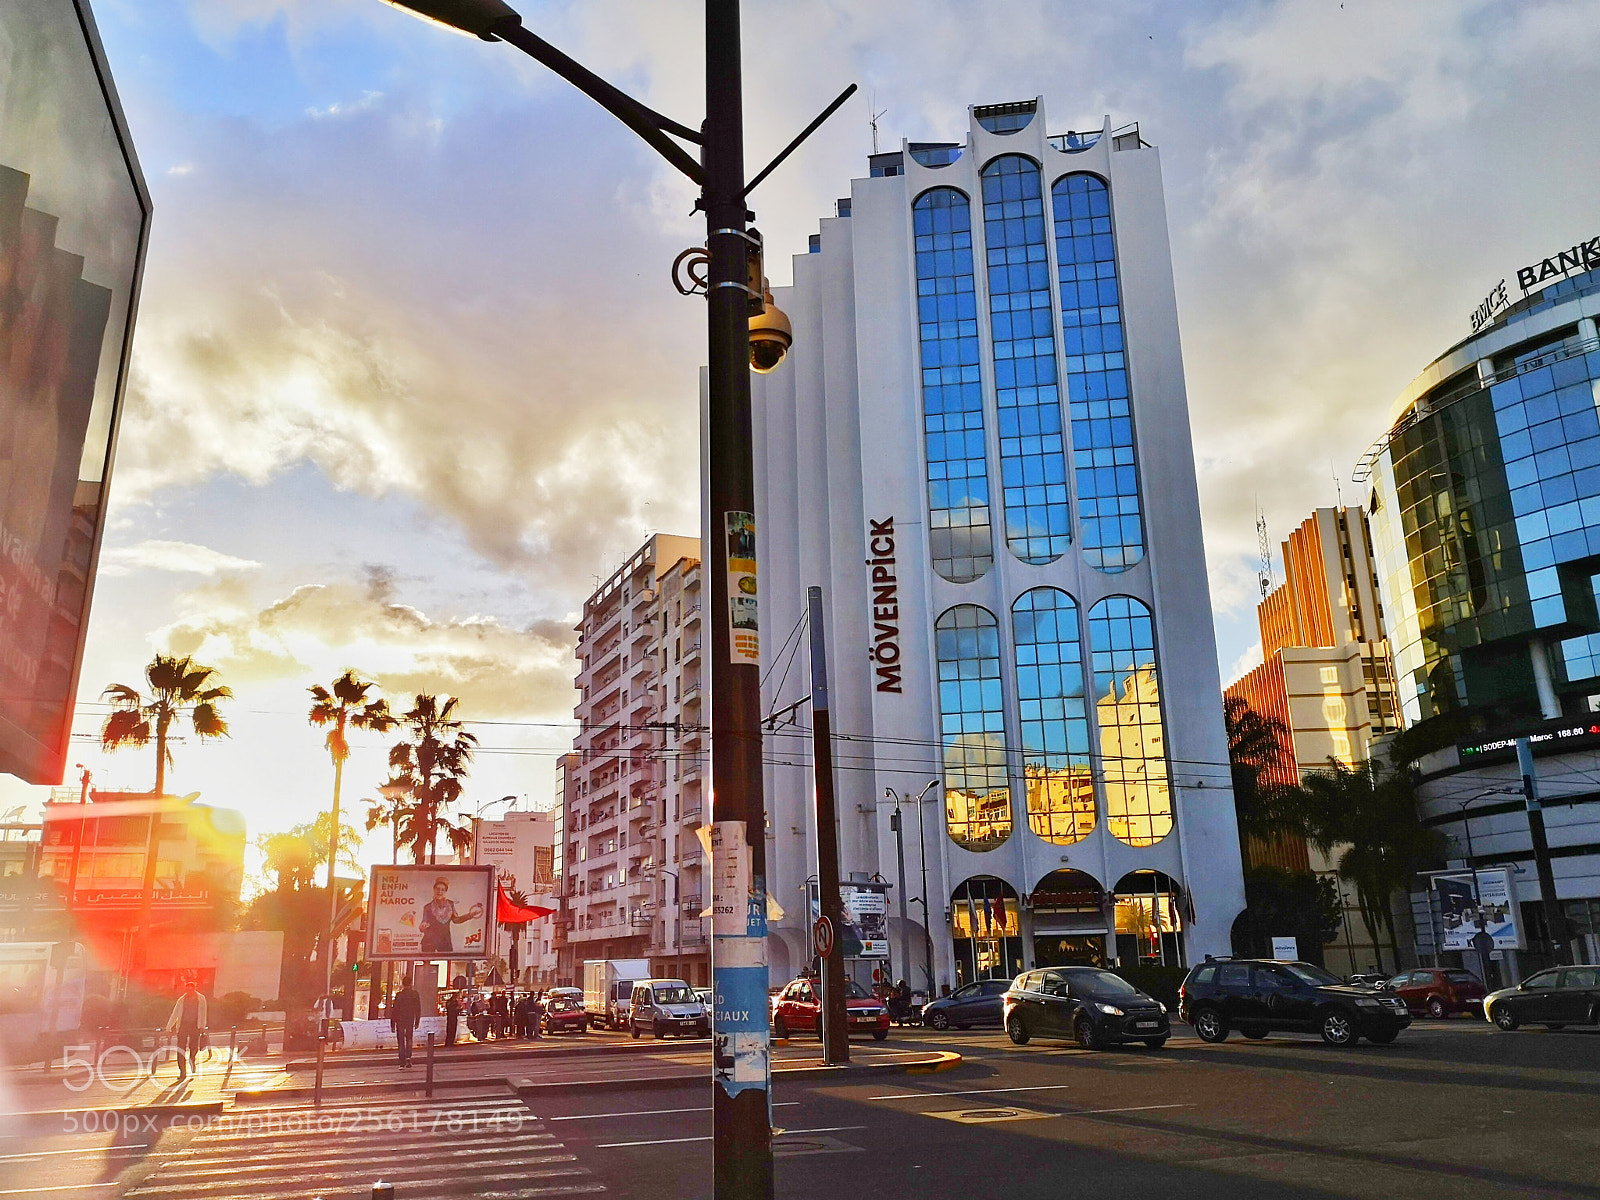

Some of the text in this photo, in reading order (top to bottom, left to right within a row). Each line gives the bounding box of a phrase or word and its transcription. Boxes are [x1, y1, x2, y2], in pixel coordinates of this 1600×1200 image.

[1470, 236, 1600, 333] BMCE BANK
[1530, 733, 1553, 742] Maroc
[1557, 726, 1584, 738] 168.60
[381, 883, 409, 891] ENFIN
[381, 890, 394, 898] AU
[713, 1010, 750, 1022] CIAUX
